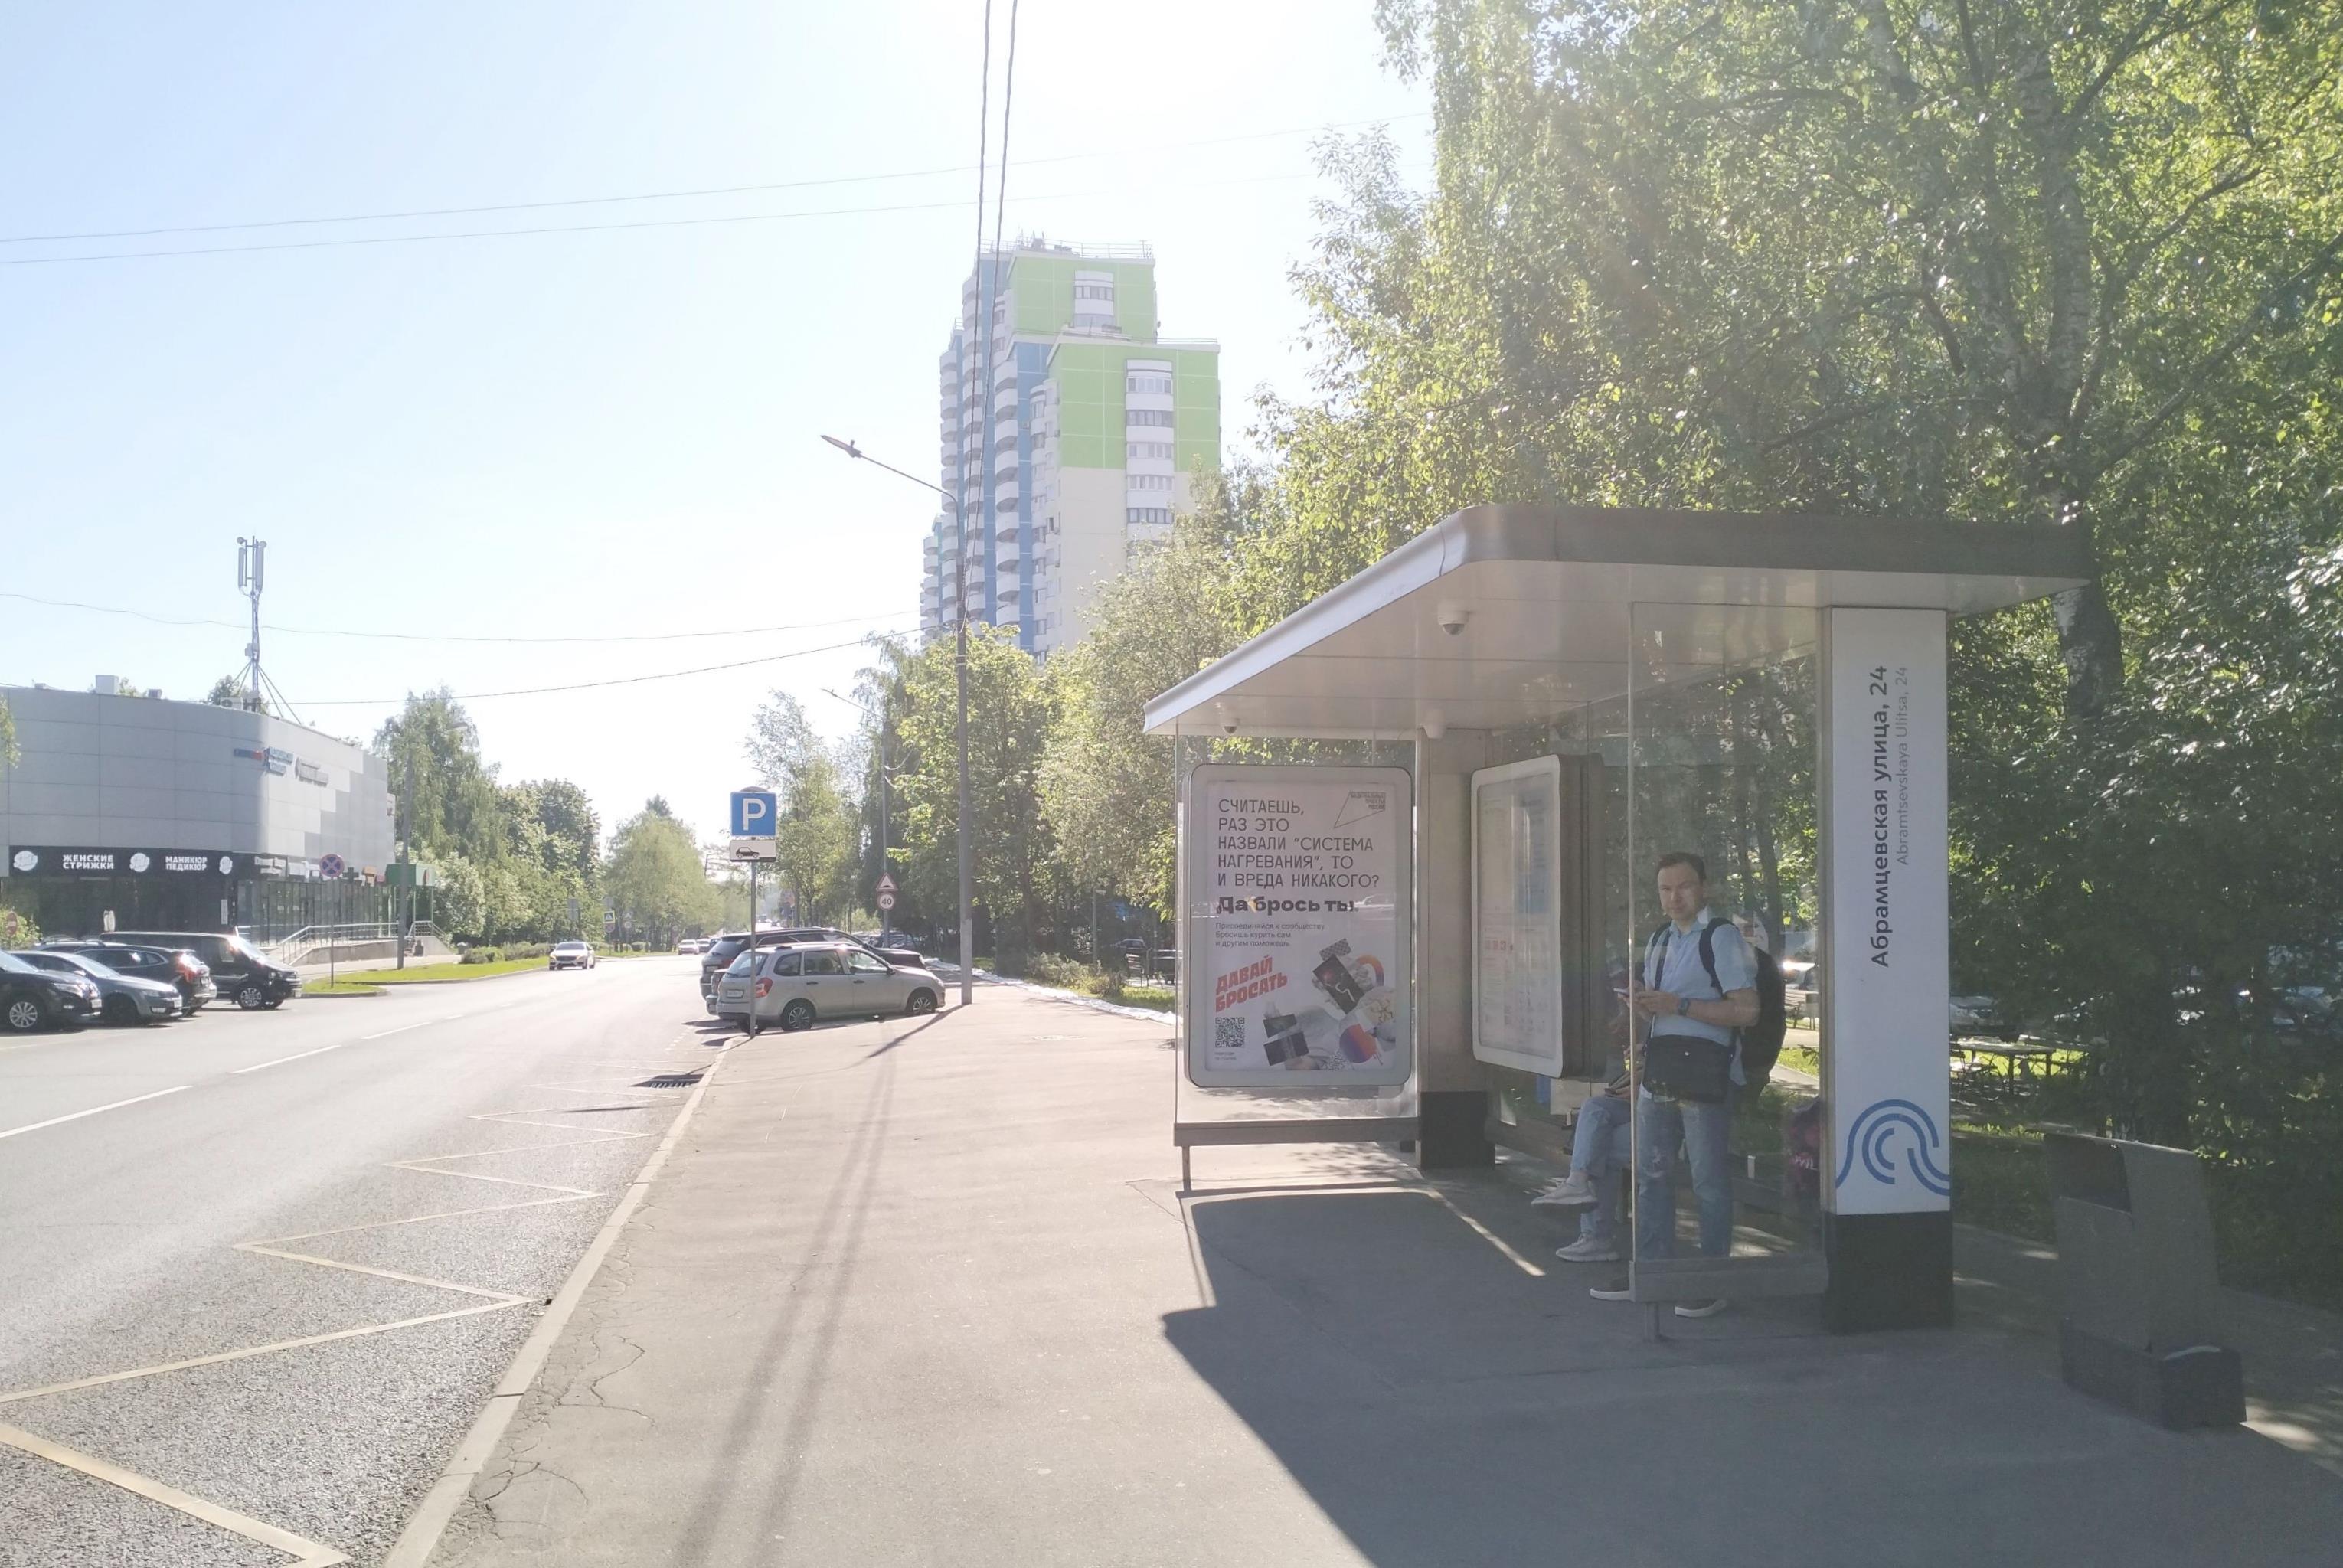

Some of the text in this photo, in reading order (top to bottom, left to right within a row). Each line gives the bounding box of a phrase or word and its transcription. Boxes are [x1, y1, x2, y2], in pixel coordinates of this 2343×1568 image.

[1895, 668, 1910, 866] Abramtsevskaya Ulitsa, 24
[743, 798, 766, 831] P
[1218, 799, 1304, 815] СЧИТАЕШЬ,
[1218, 818, 1289, 831] РАЗ ЭТО
[1870, 666, 1893, 968] Абрамцевская улица, 24
[1218, 836, 1286, 850] НАЗВАЛИ
[165, 863, 207, 871] ПЕДИКЮР
[1332, 855, 1354, 869] ТО
[1218, 873, 1380, 889] И ВРЕДА НИКАКОГО?
[1217, 896, 1249, 914] Да
[1253, 896, 1321, 916] брось
[1216, 923, 1274, 931] Присоединяйся
[1216, 954, 1273, 995] ДАВАЙ
[1216, 972, 1288, 1013] БРОСАТЬ
